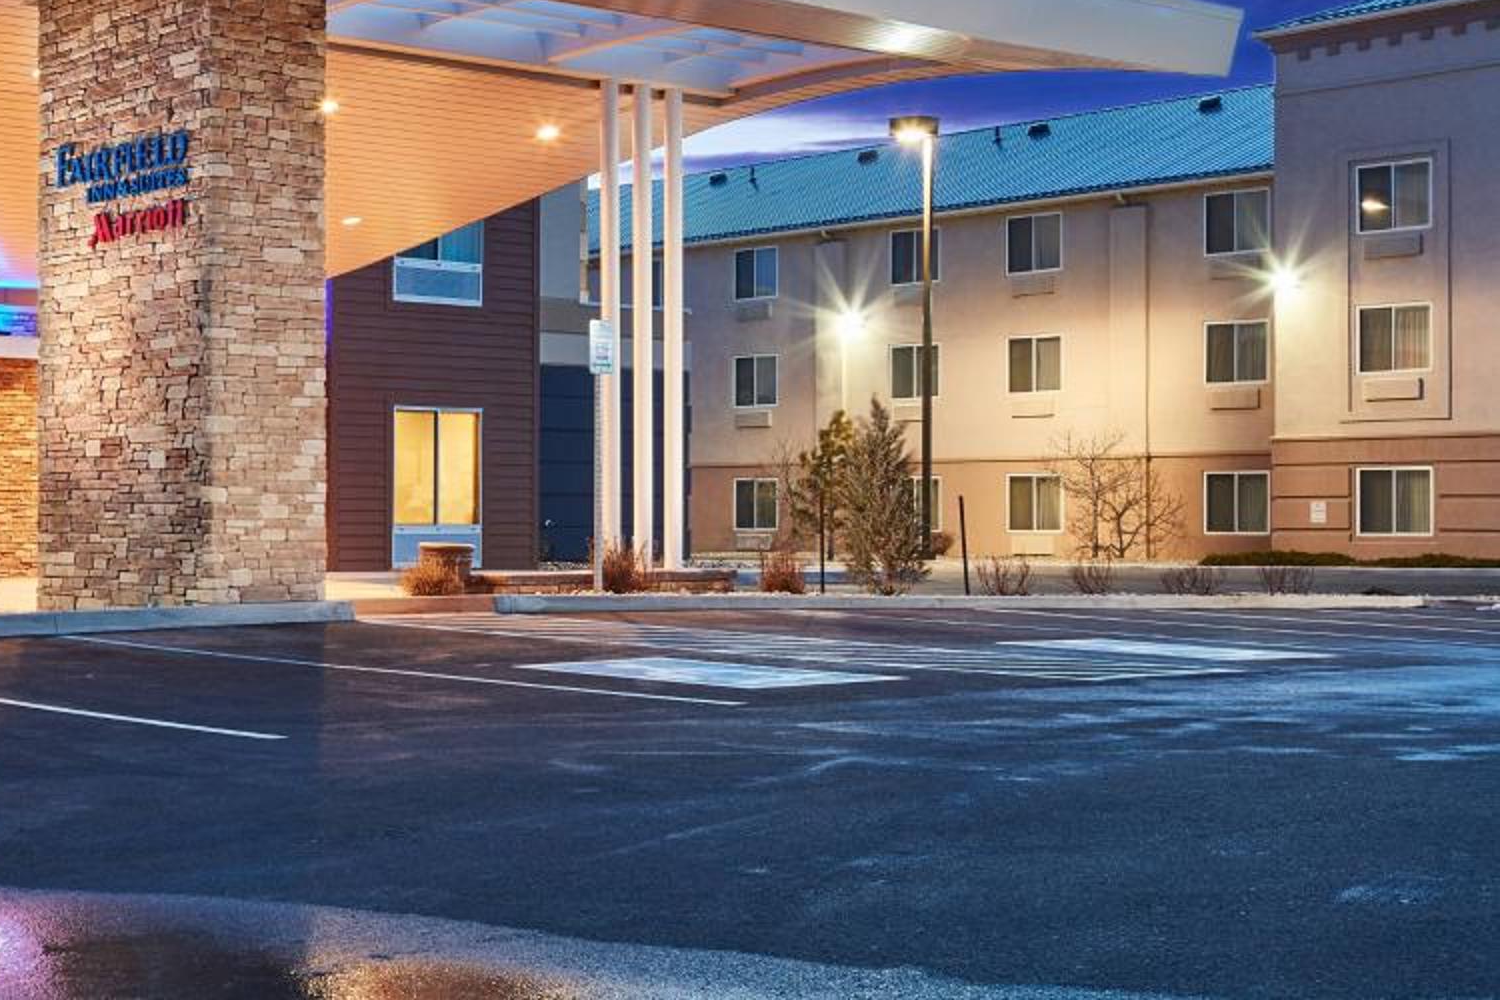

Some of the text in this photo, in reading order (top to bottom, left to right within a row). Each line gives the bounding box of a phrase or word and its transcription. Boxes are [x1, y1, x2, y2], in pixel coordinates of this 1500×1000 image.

[56, 128, 189, 188] FAIRFIELD
[87, 182, 117, 203] INN
[87, 198, 186, 249] Marriott
